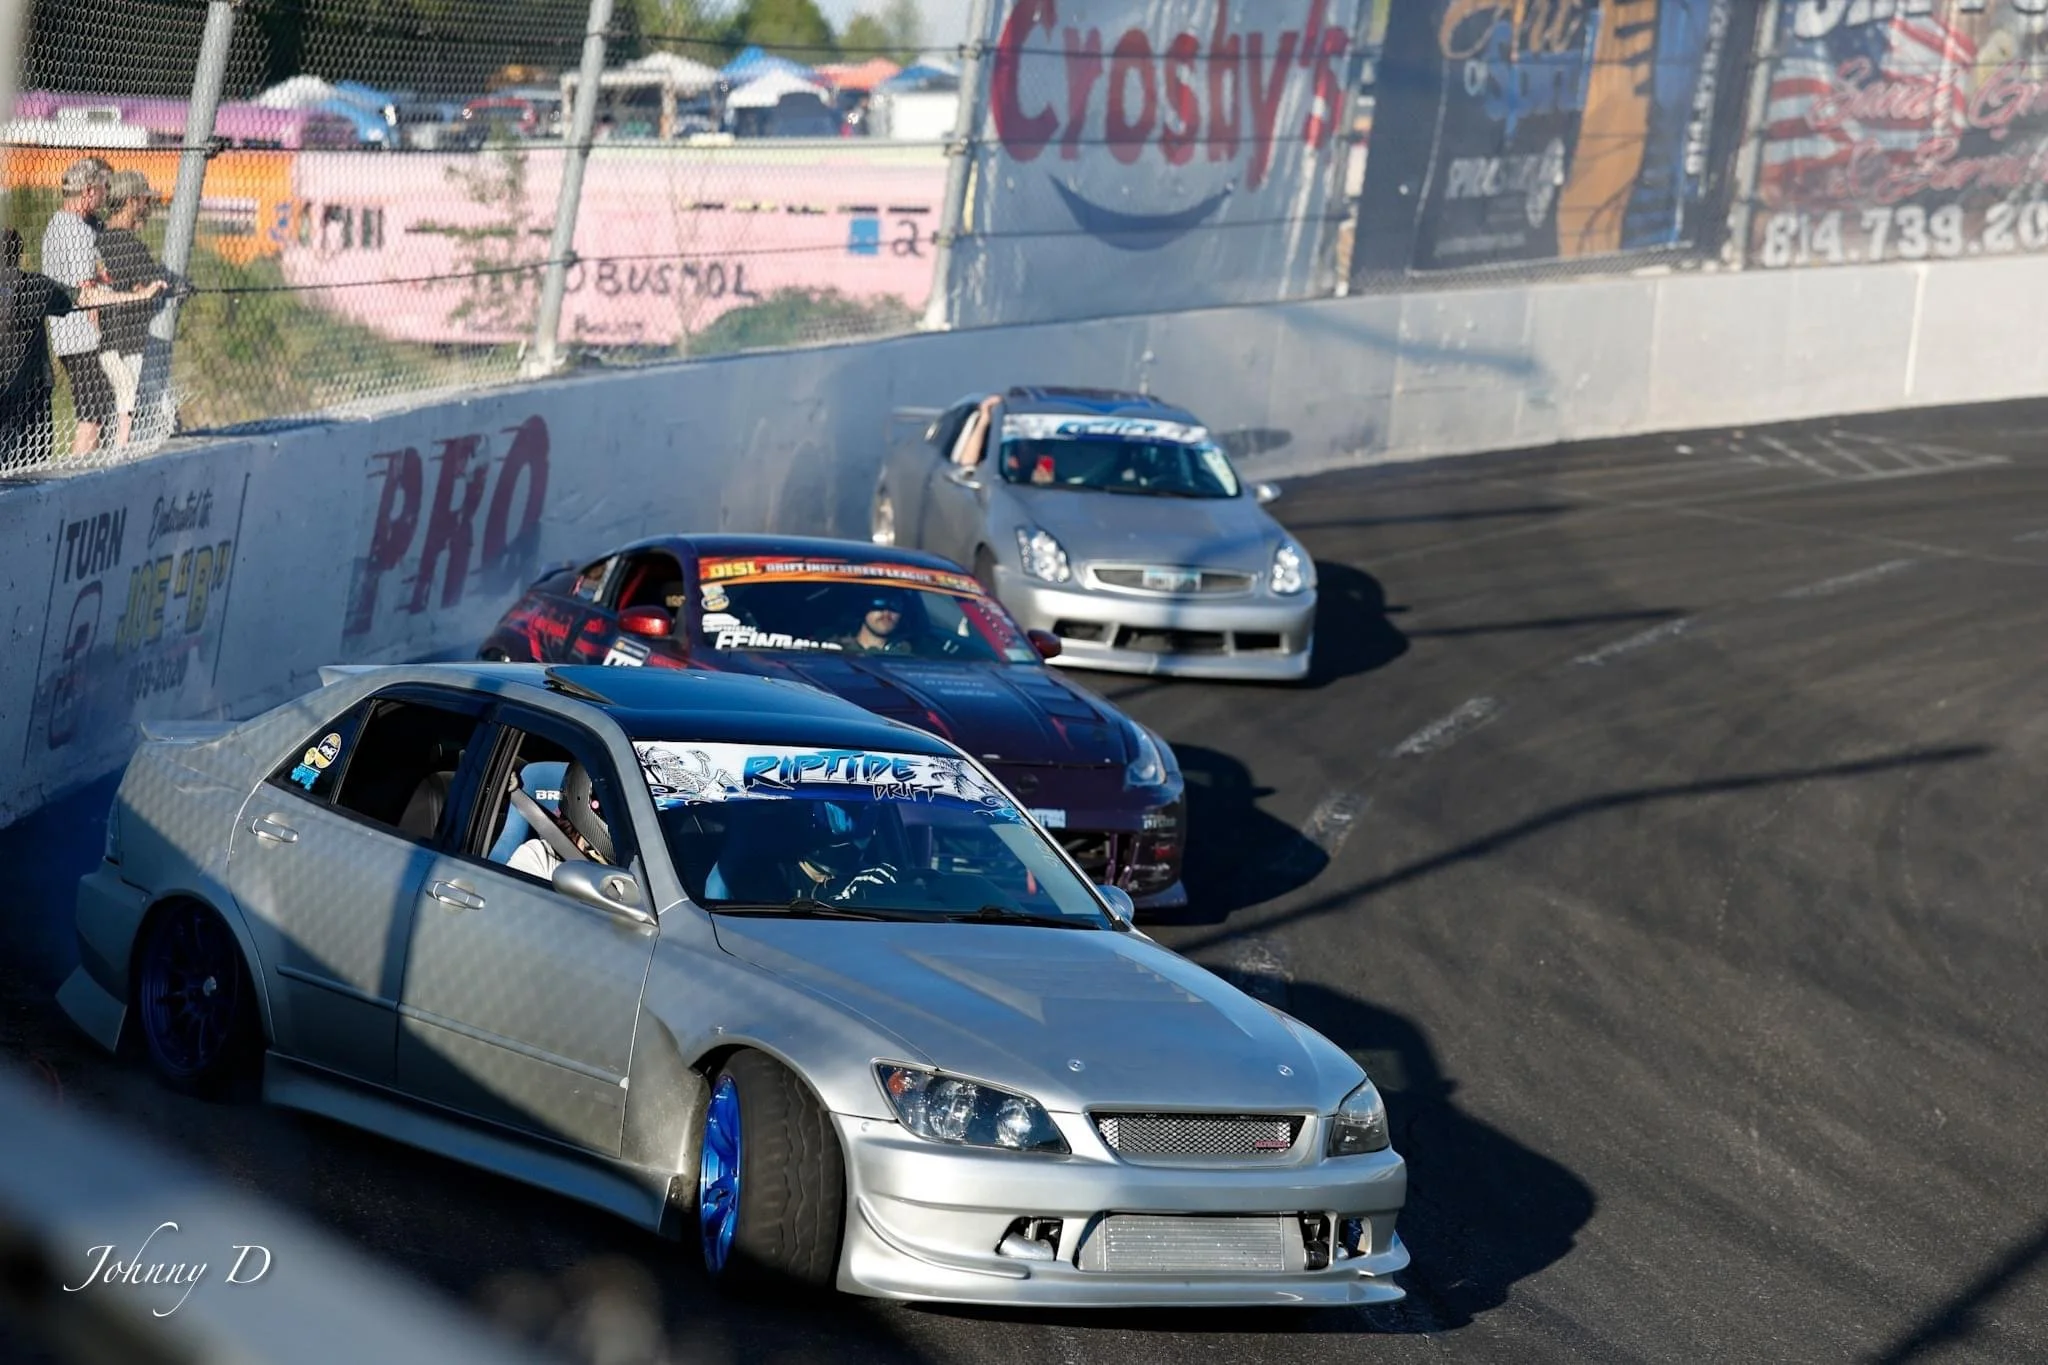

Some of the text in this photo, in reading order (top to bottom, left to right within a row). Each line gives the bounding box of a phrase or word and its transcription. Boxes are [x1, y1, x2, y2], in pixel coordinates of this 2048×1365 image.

[990, 0, 1351, 193] Crosby's
[64, 505, 128, 584] TURN
[343, 414, 550, 637] PRO
[114, 554, 174, 662] JOE
[743, 749, 917, 791] RIPTIDE
[873, 781, 945, 802] DRIFT
